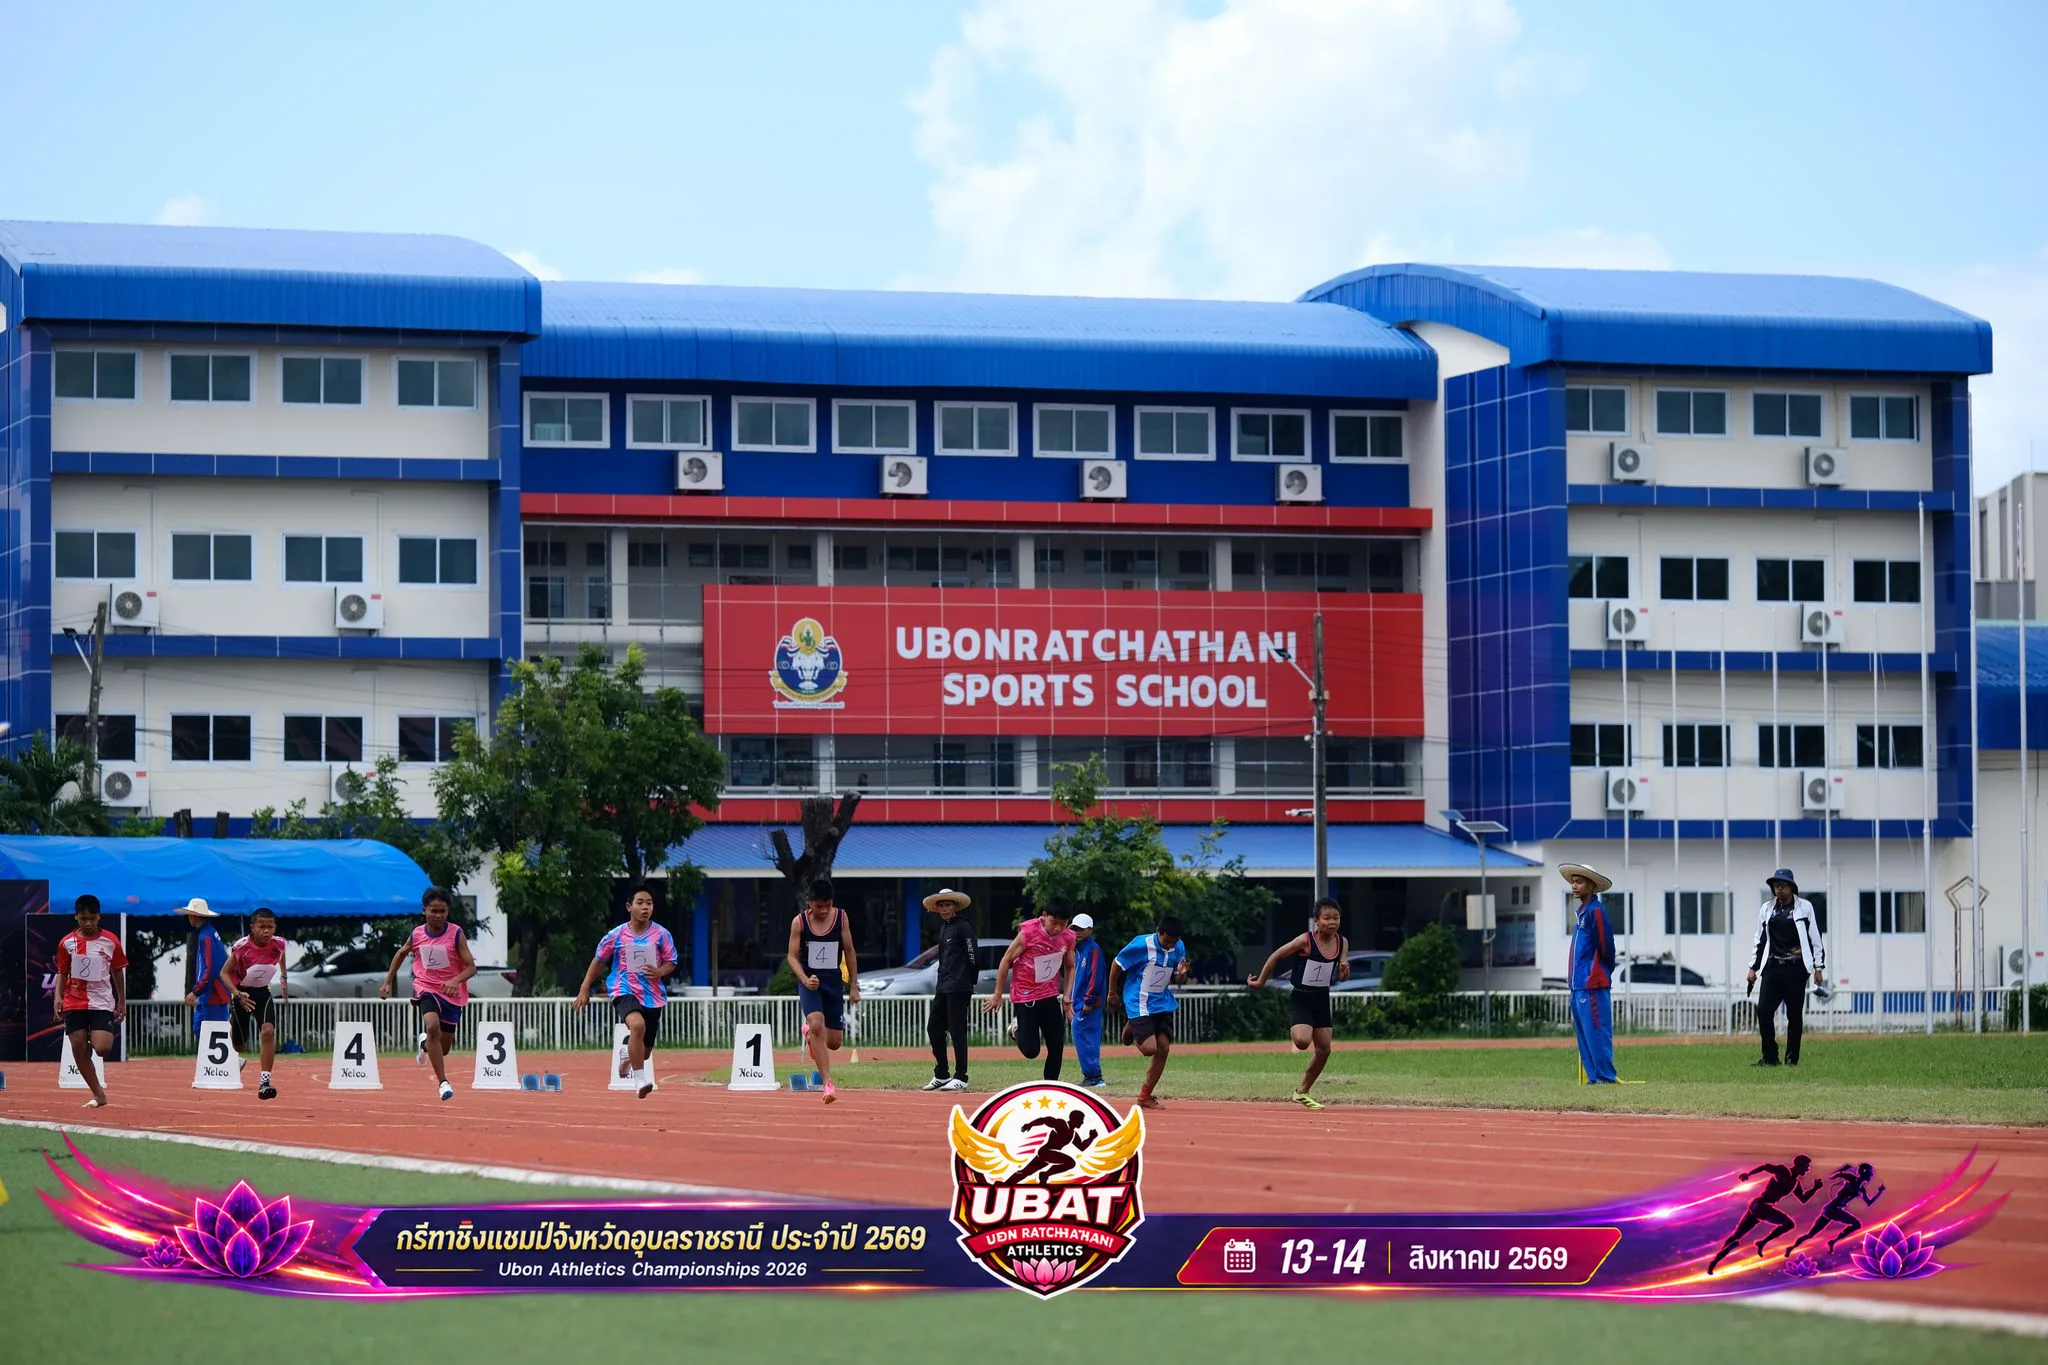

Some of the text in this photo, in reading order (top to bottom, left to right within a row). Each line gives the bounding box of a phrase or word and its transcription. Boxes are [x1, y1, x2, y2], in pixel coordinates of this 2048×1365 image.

[896, 626, 1297, 663] UBONRATCHATHANI
[943, 672, 1267, 708] SPORTS SCHOOL
[79, 957, 91, 978] 8
[633, 950, 647, 969] 5
[815, 946, 829, 963] 4
[1042, 960, 1053, 980] 3
[1150, 970, 1166, 988] 2
[1309, 965, 1324, 983] 1
[208, 1031, 230, 1065] 5
[344, 1033, 366, 1066] 4
[486, 1032, 506, 1065] 3
[746, 1033, 762, 1067] 1
